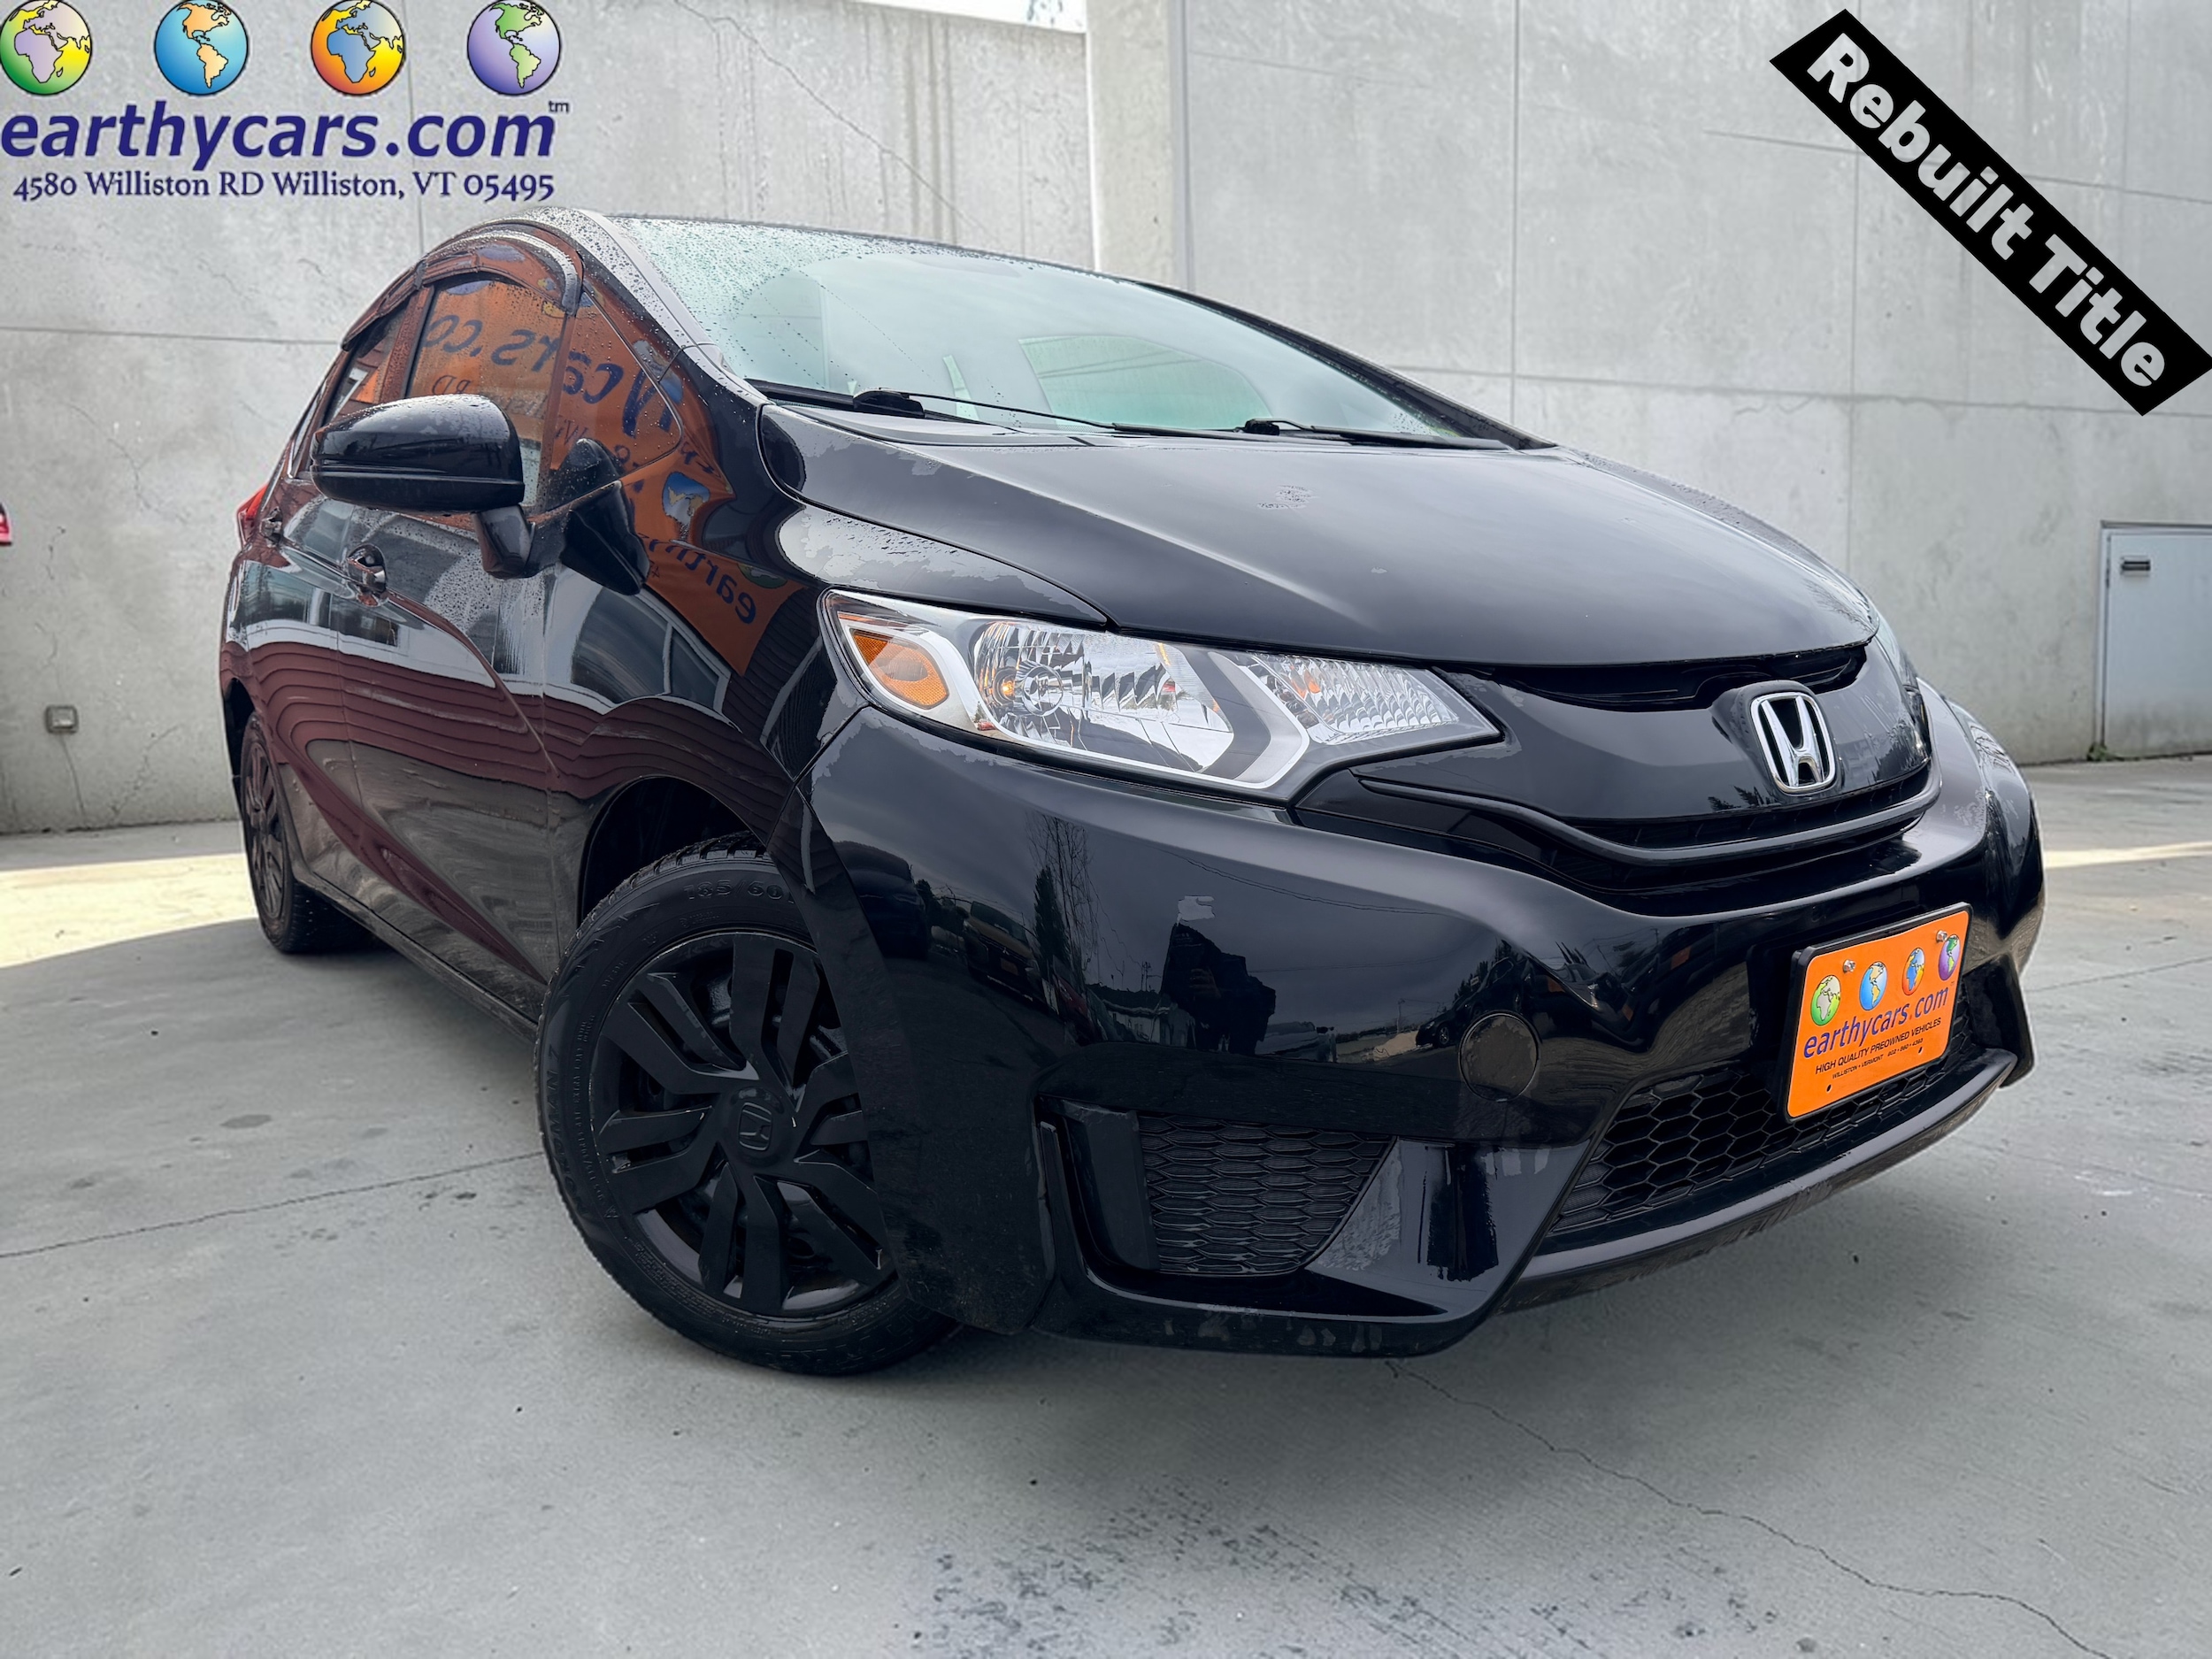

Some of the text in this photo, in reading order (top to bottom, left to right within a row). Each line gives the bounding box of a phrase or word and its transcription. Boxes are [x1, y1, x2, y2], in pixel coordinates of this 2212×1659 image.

[683, 879, 795, 904] 185/60
[1803, 987, 1948, 1058] earthycars.com
[1815, 1018, 1941, 1074] HIGH QUALITY PREOWNED VEHICLES
